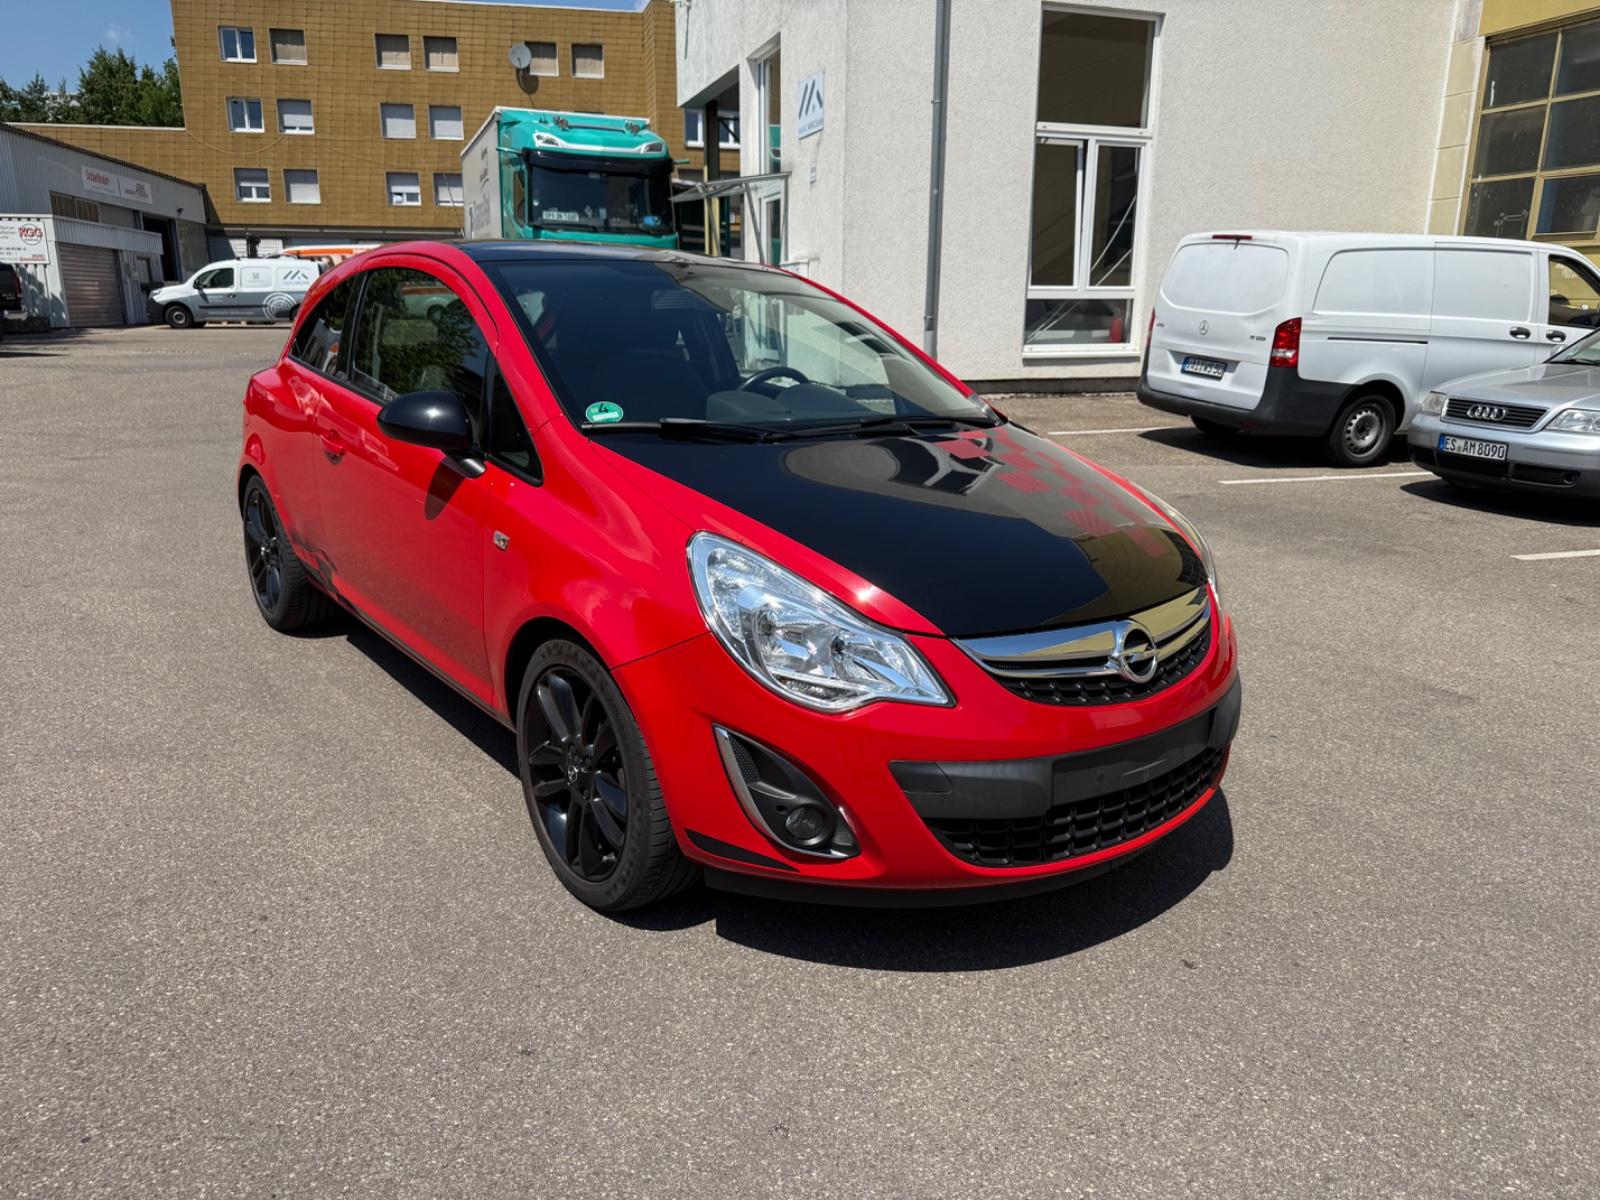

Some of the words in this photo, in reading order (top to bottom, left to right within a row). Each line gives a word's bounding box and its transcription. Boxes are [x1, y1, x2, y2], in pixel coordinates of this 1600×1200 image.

[18, 226, 44, 238] KGG
[599, 403, 608, 413] 4
[1445, 437, 1456, 451] ES
